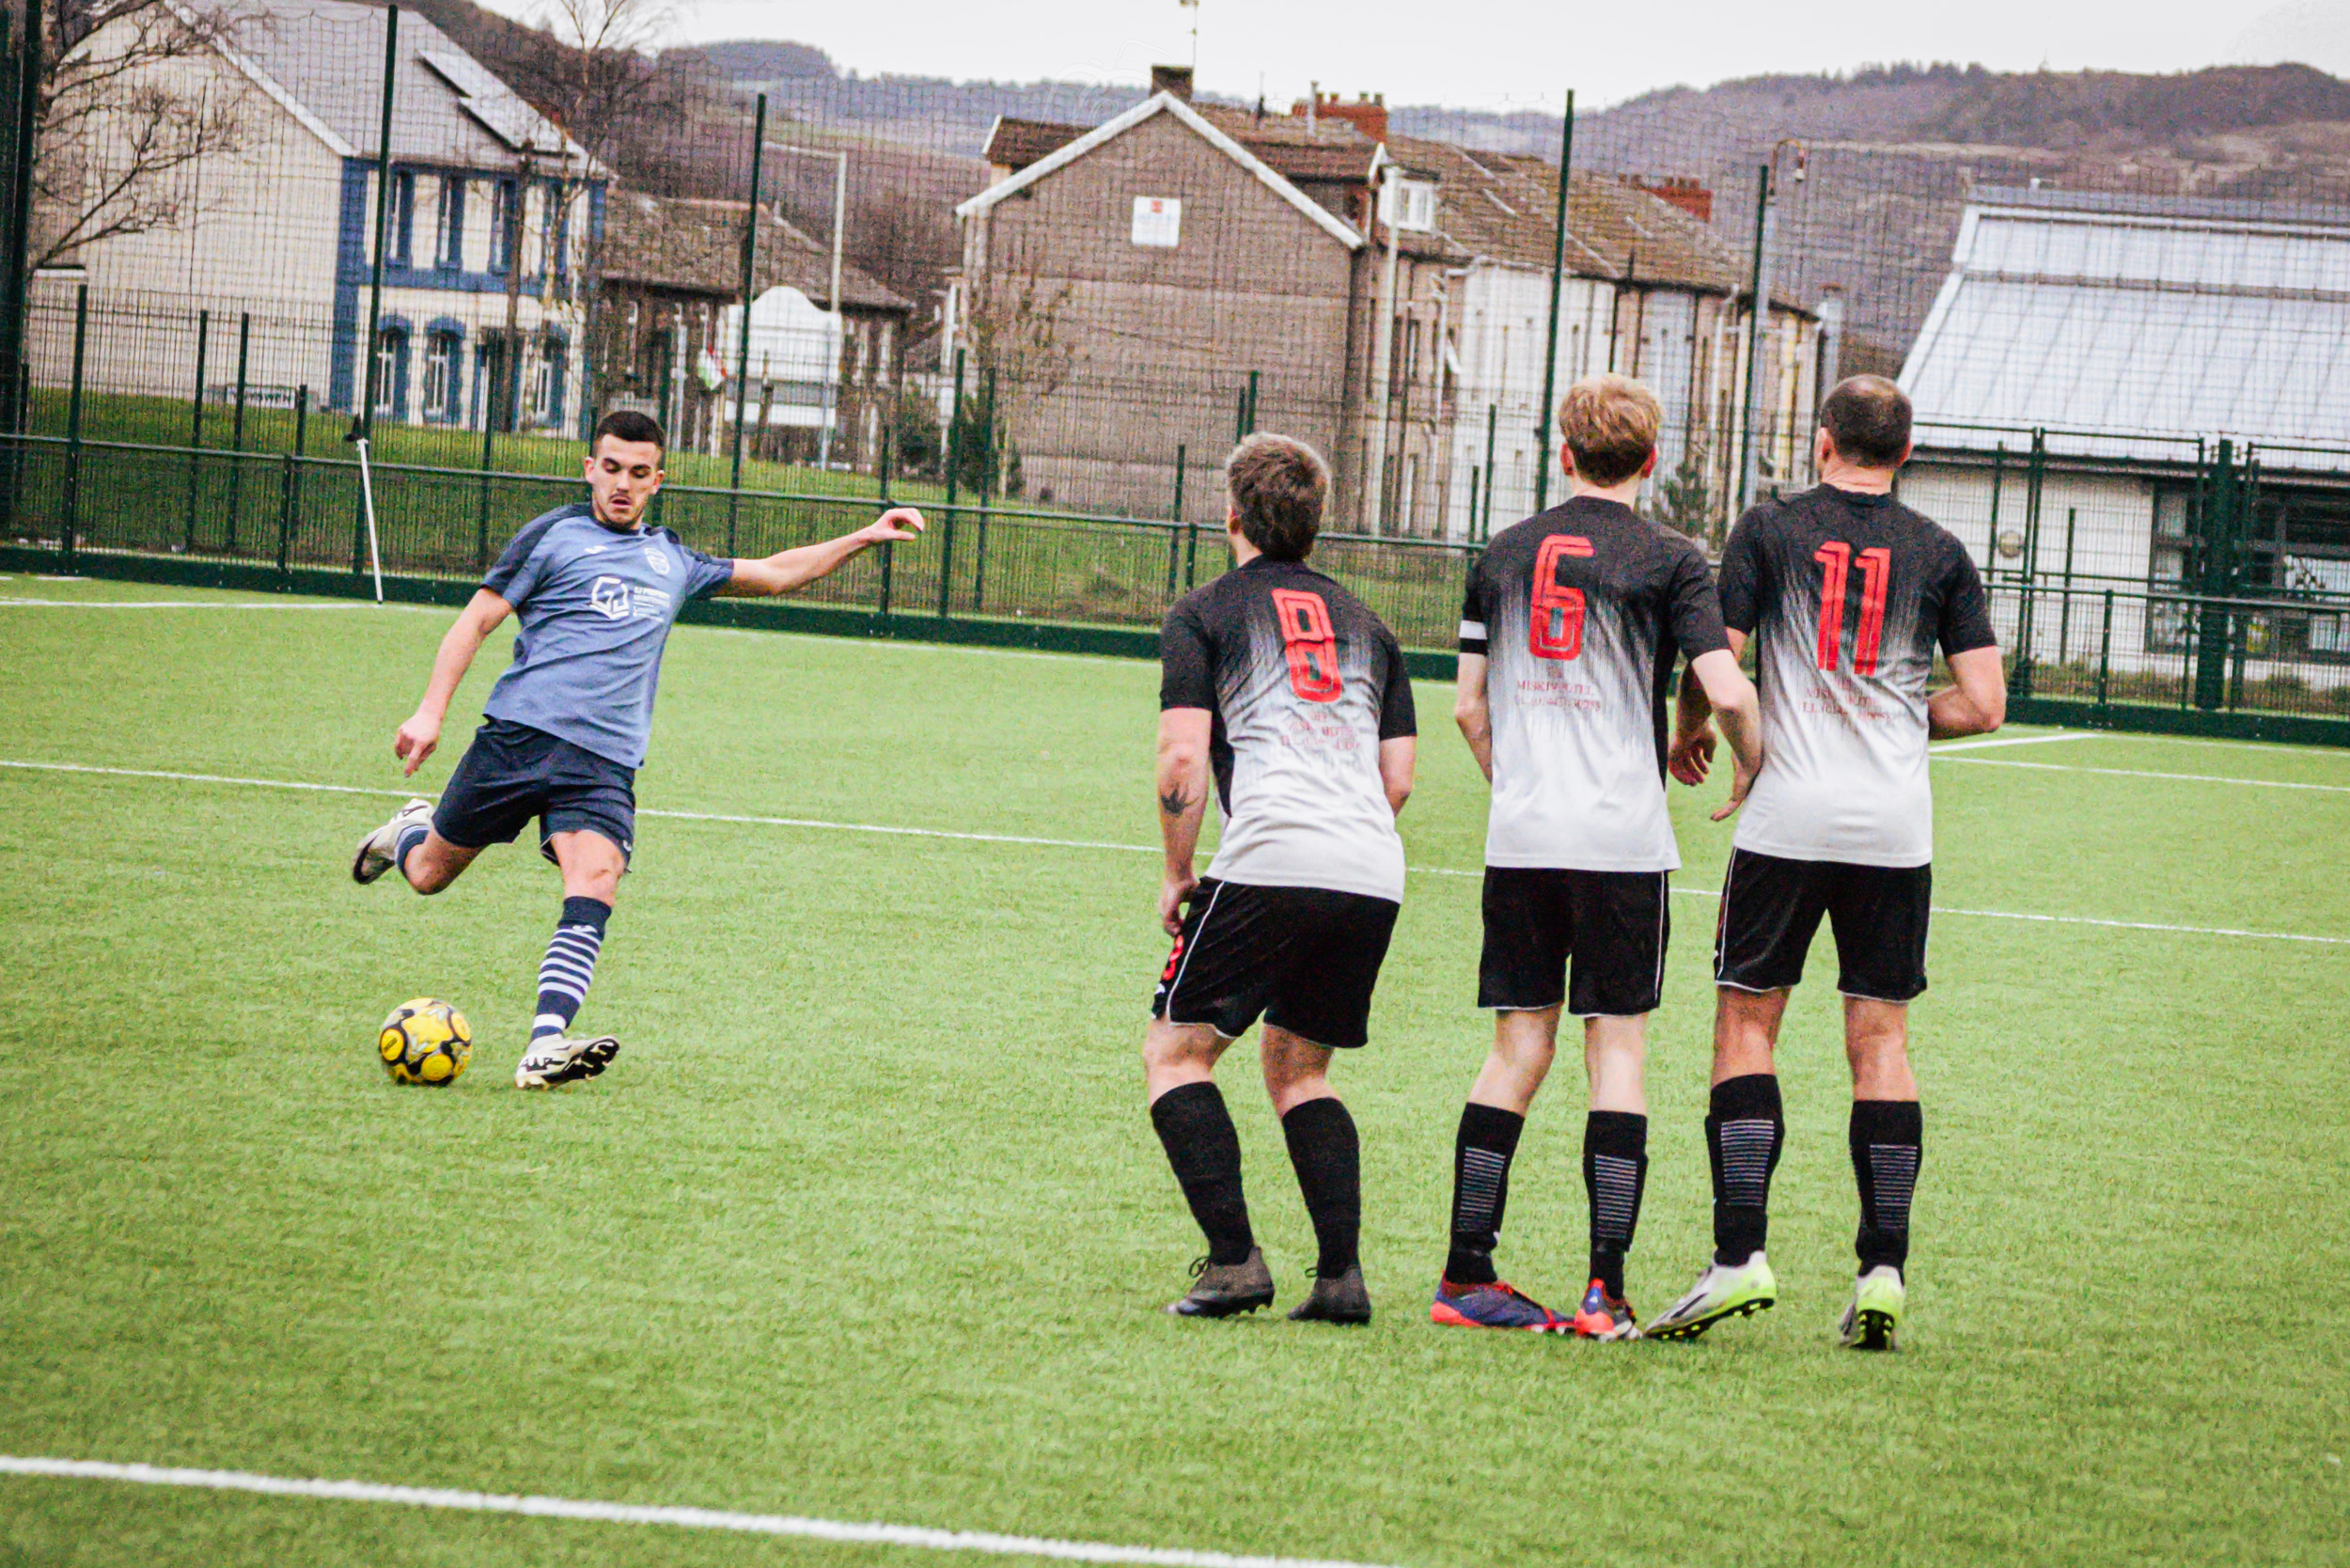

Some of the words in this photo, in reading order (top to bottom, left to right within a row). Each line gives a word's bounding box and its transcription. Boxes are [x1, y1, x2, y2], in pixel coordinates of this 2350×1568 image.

[1271, 588, 1342, 703] 8
[1529, 535, 1595, 661] 6
[1814, 541, 1891, 677] 11
